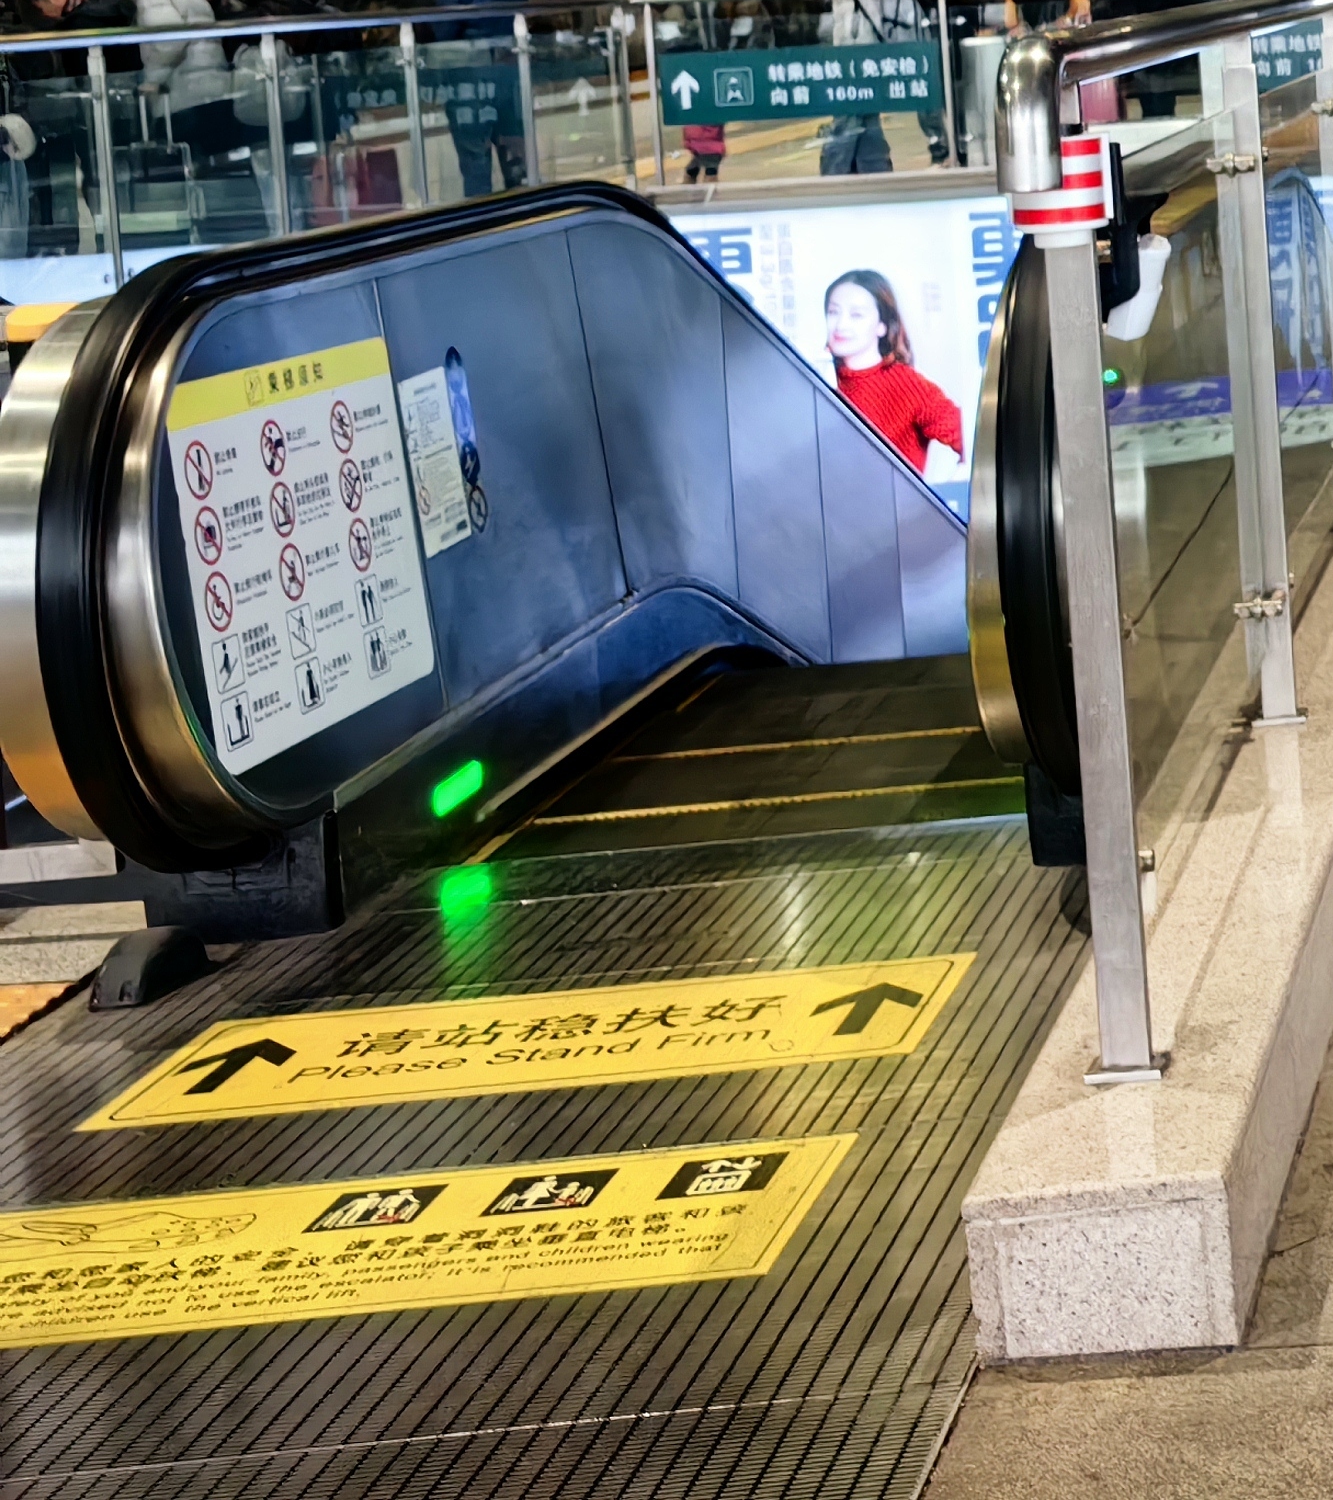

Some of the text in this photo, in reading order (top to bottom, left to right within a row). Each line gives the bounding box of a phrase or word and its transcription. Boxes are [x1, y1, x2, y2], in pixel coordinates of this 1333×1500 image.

[336, 994, 789, 1058] 请站稳扶好
[287, 1028, 772, 1083] Please Stand Firm
[341, 1256, 477, 1279] passengers
[485, 1250, 531, 1263] and
[538, 1242, 630, 1259] children
[640, 1232, 729, 1248] wearing
[502, 1247, 668, 1271] recommended
[677, 1242, 723, 1255] that
[184, 1303, 221, 1314] the
[231, 1291, 320, 1308] vertical
